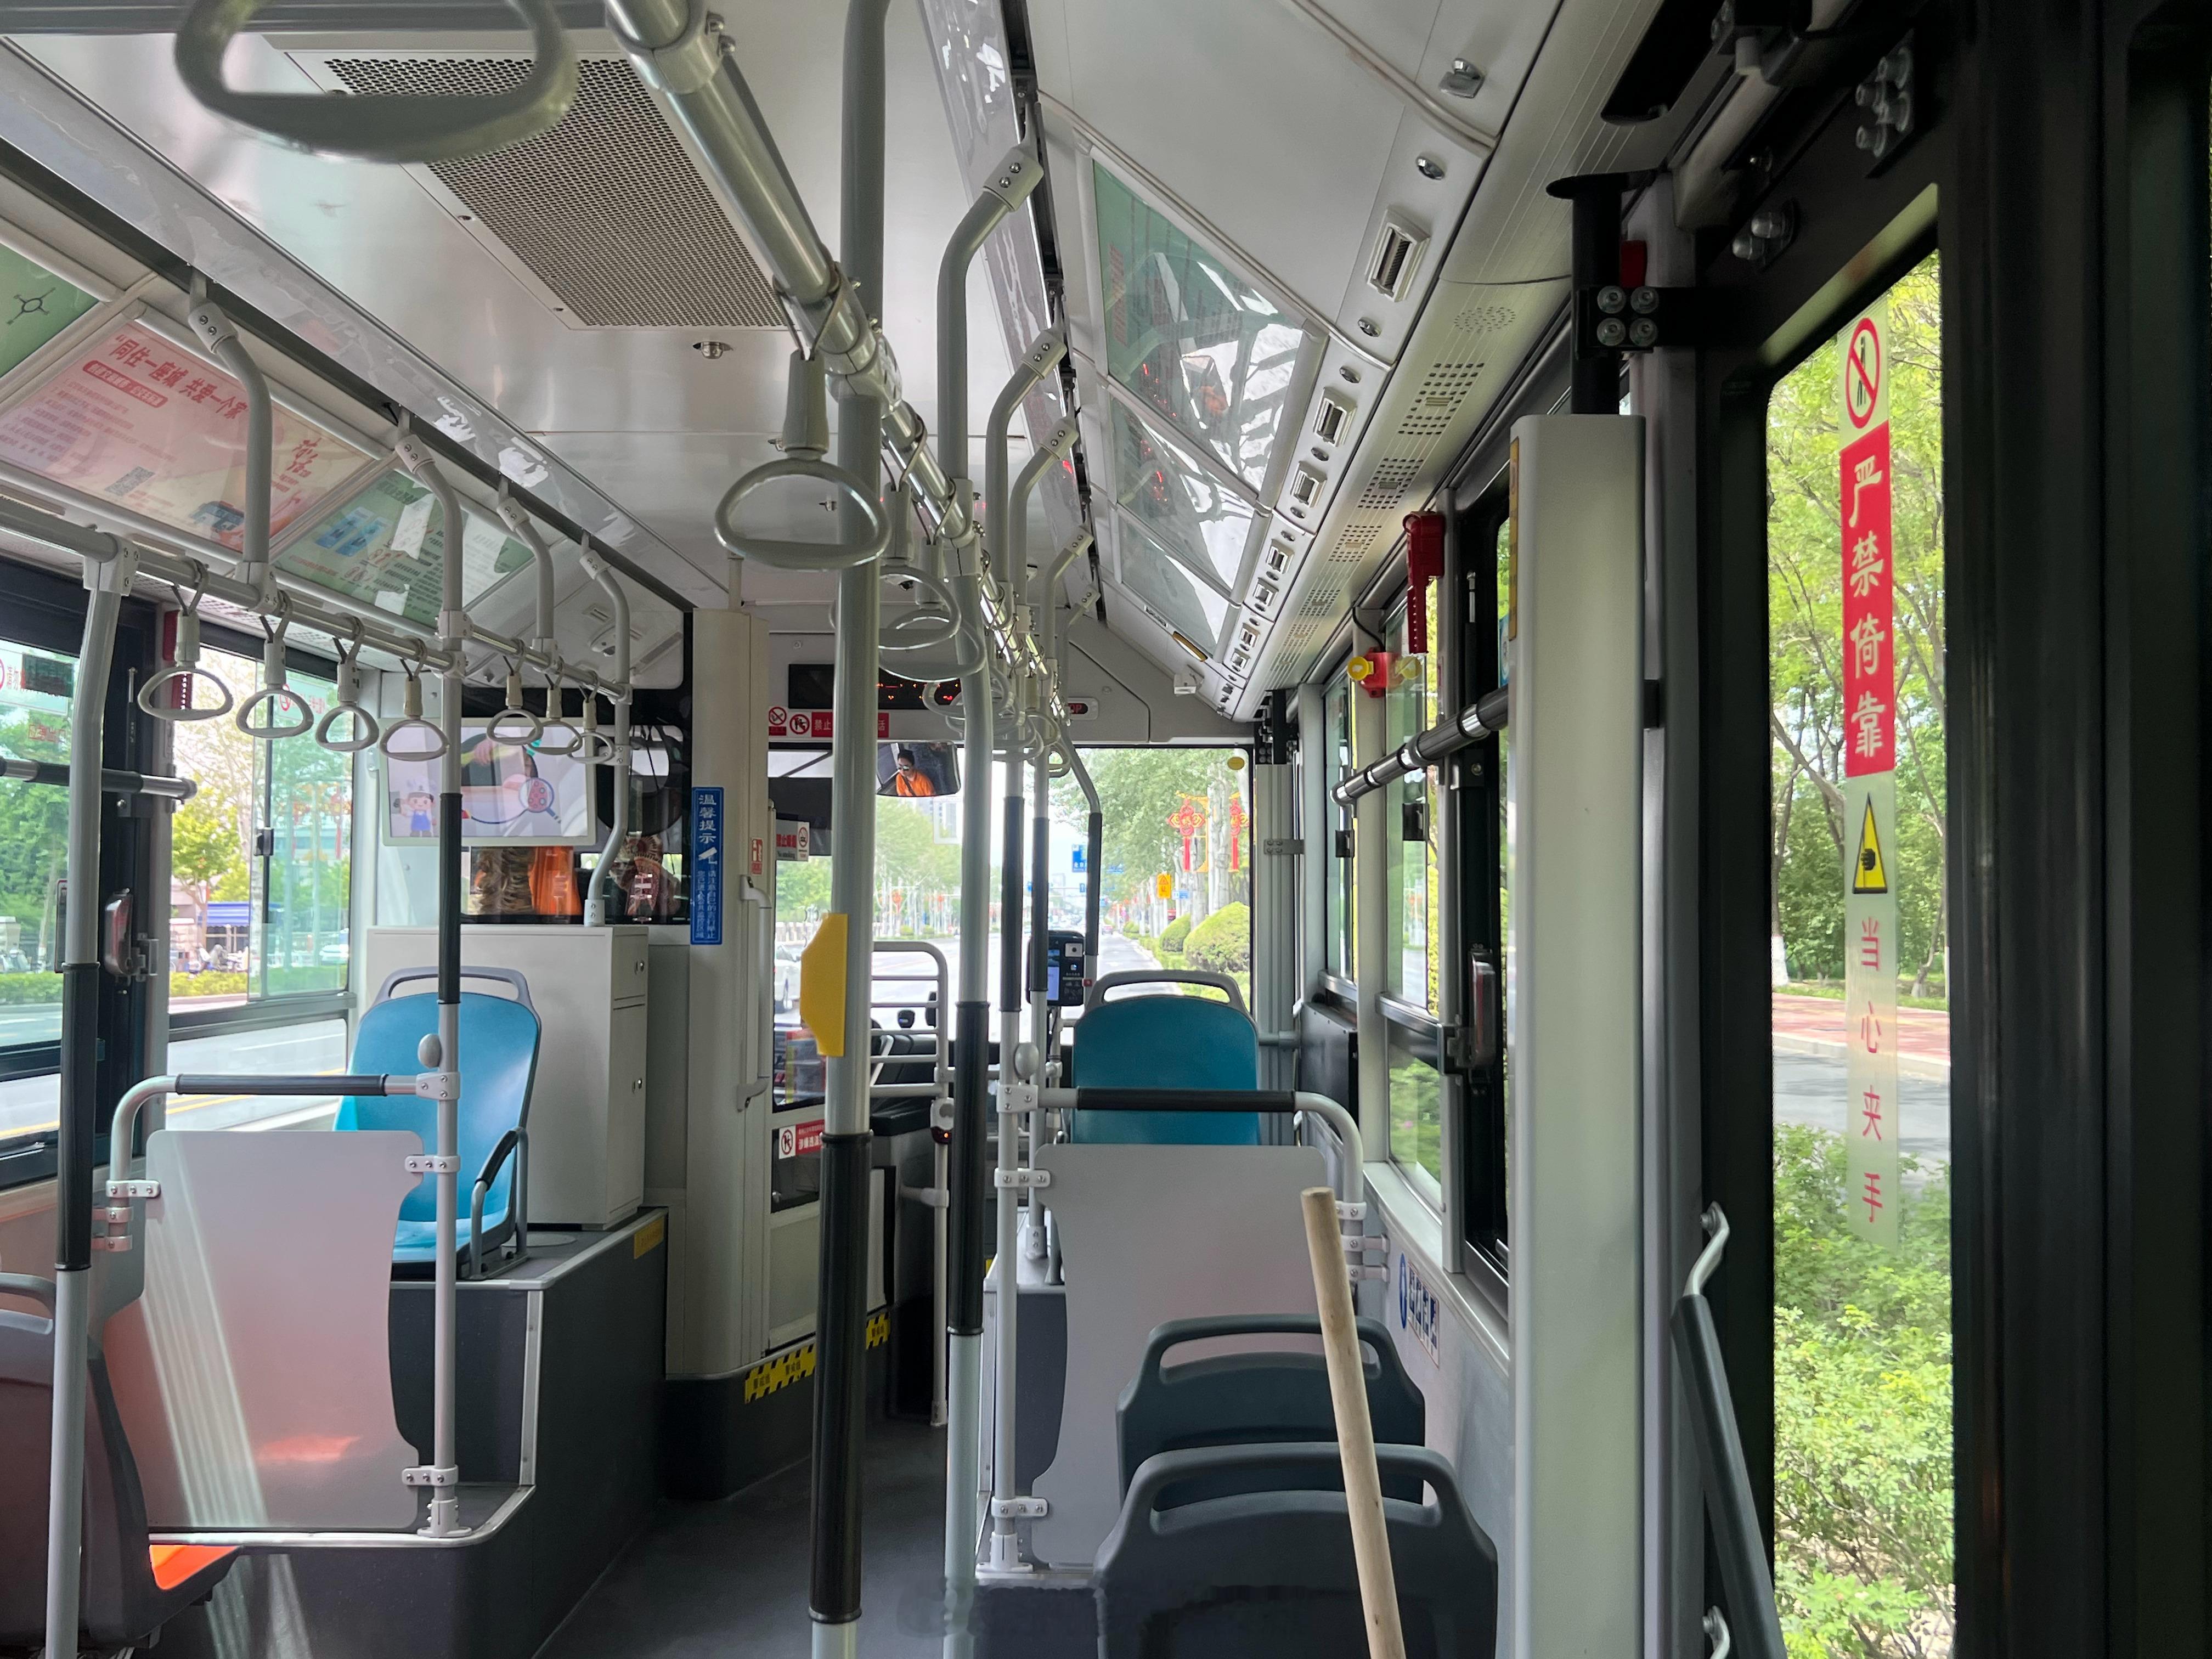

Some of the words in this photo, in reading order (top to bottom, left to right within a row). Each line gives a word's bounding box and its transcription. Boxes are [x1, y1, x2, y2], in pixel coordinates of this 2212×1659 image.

[1849, 455, 1885, 758] 严禁倚靠
[698, 794, 716, 844] 温馨提示
[1860, 916, 1883, 1223] 当心夹手
